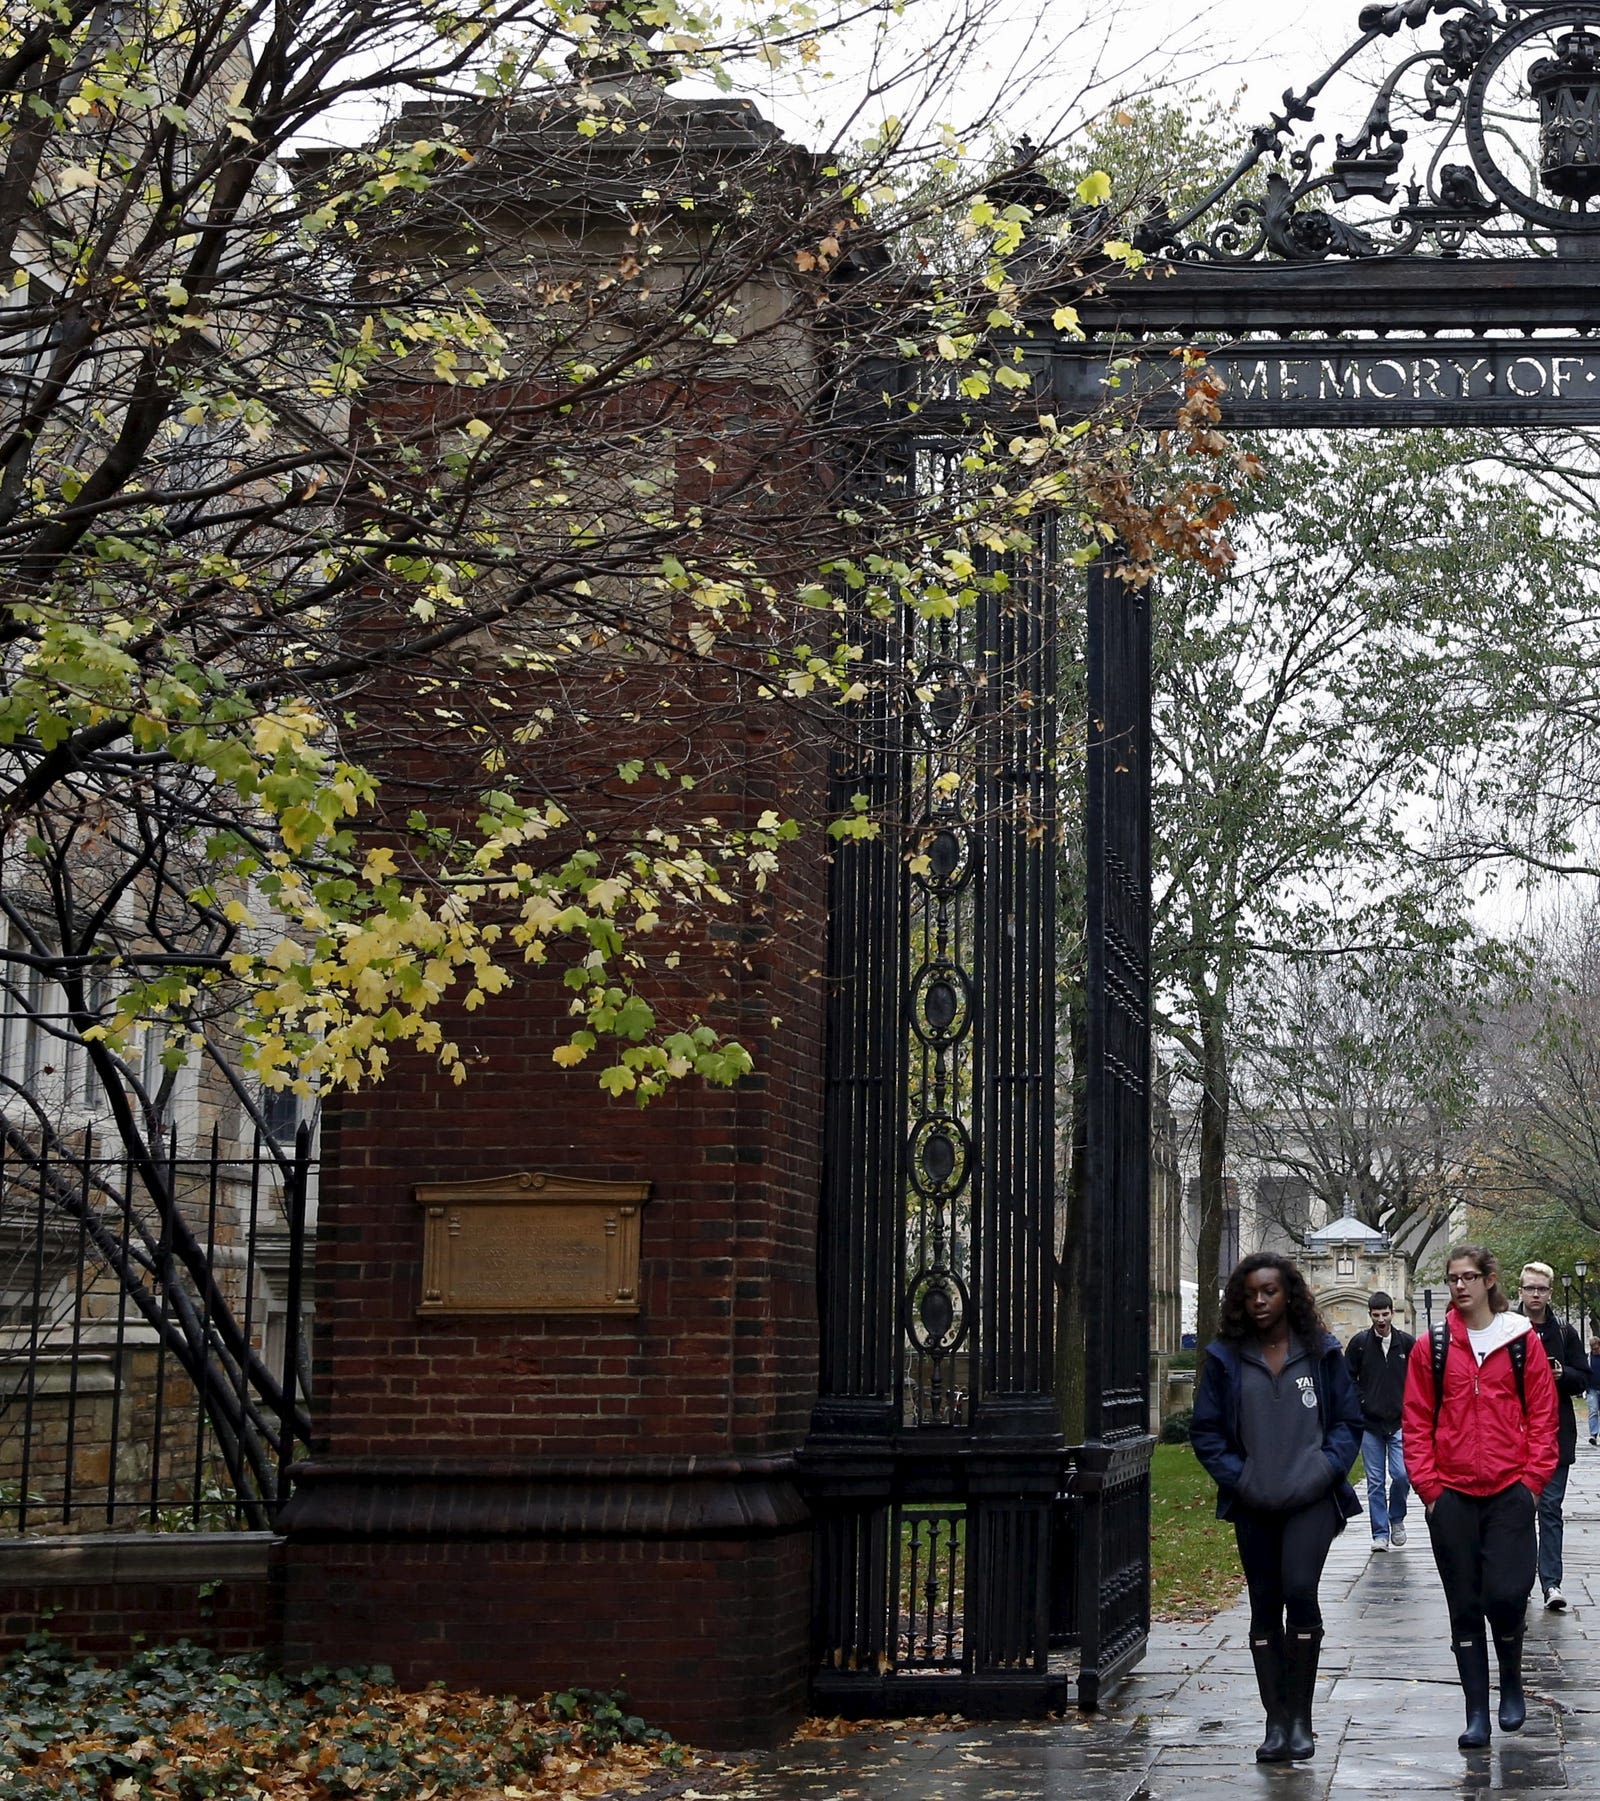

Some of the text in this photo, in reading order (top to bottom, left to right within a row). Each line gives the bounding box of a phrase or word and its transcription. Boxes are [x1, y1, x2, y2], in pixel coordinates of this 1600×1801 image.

[1225, 357, 1487, 401] MEMORY
[1506, 356, 1584, 397] OF
[1296, 1376, 1314, 1389] YAL
